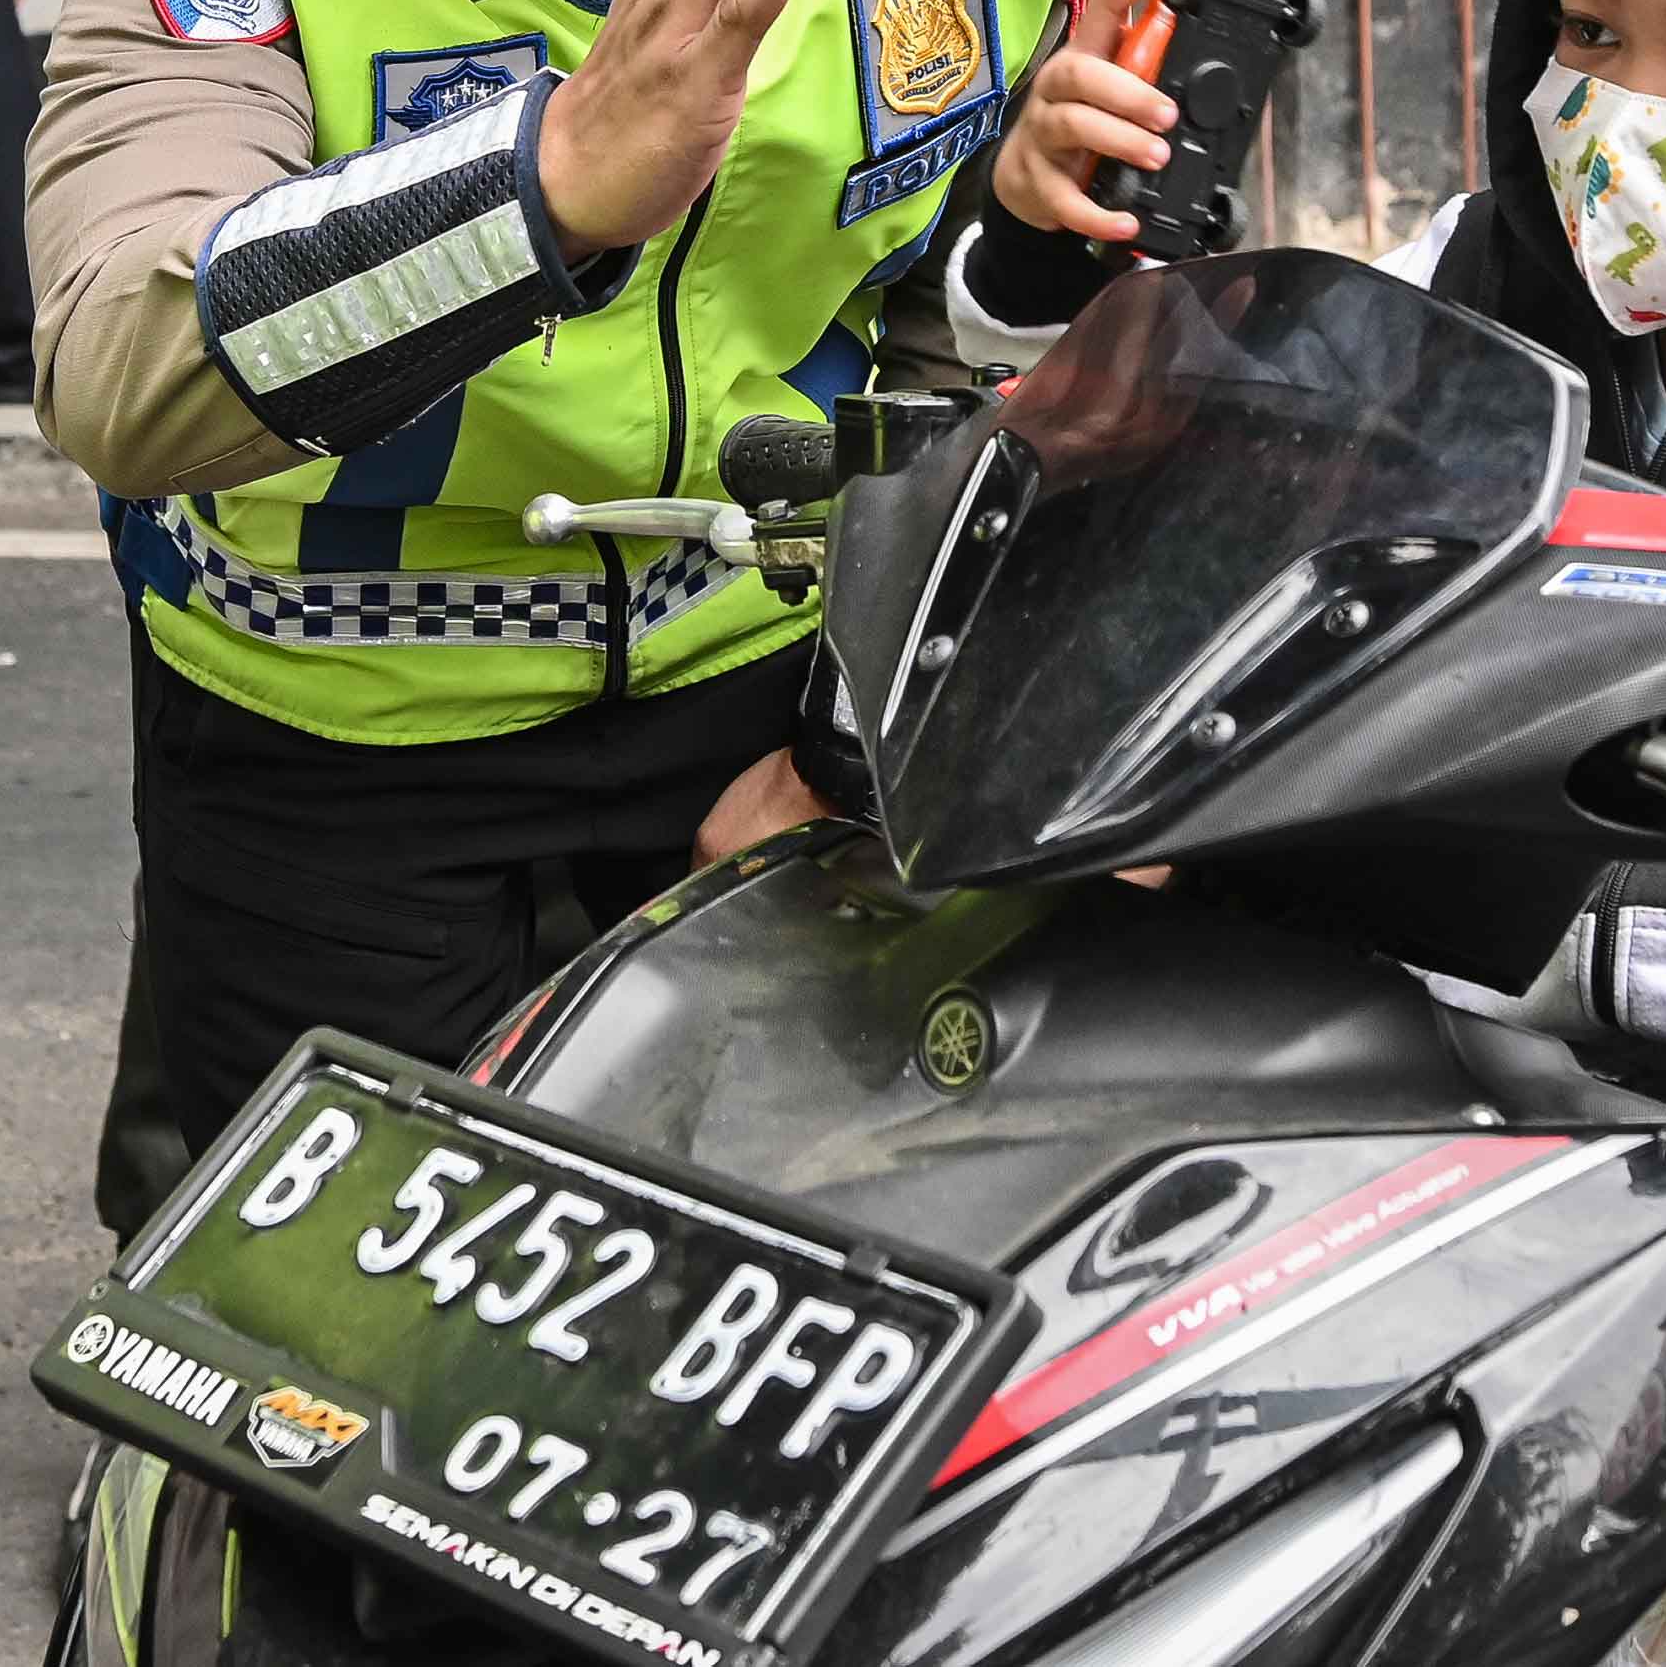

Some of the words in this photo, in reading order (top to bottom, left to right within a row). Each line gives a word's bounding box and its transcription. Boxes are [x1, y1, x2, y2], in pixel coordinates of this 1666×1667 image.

[906, 51, 952, 84] POLISI
[238, 1106, 360, 1227] B
[356, 1147, 657, 1362] 5452
[649, 1262, 916, 1459] BFP
[1148, 1283, 1243, 1348] VVA
[98, 1326, 239, 1427] YAMAHA
